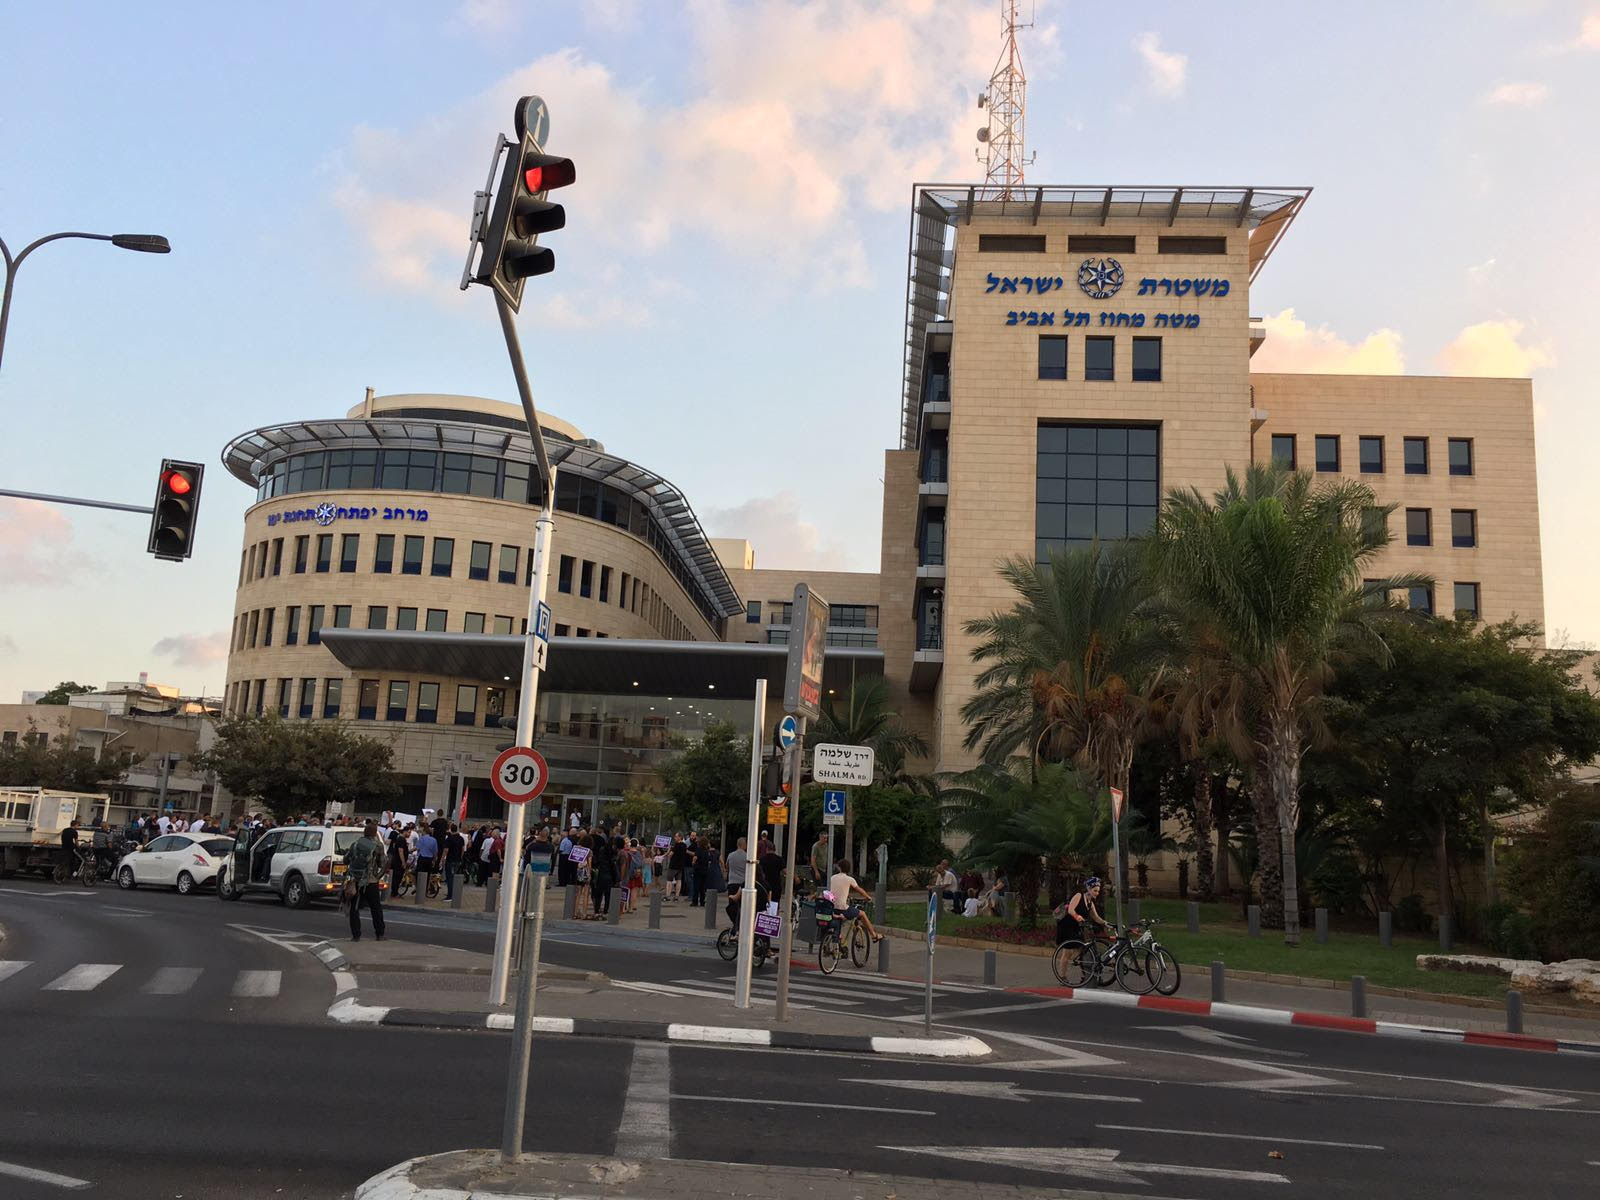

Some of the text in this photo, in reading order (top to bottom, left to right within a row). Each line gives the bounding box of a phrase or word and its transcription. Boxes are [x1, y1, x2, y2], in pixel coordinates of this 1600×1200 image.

[984, 272, 1231, 297] משטרת ישראל
[1005, 308, 1201, 329] מטה מחוז תל אביב
[337, 506, 378, 520] יפתח
[383, 507, 429, 522] מרחב
[820, 748, 852, 759] שלמה
[504, 763, 535, 786] 30
[818, 769, 855, 780] SHALMA
